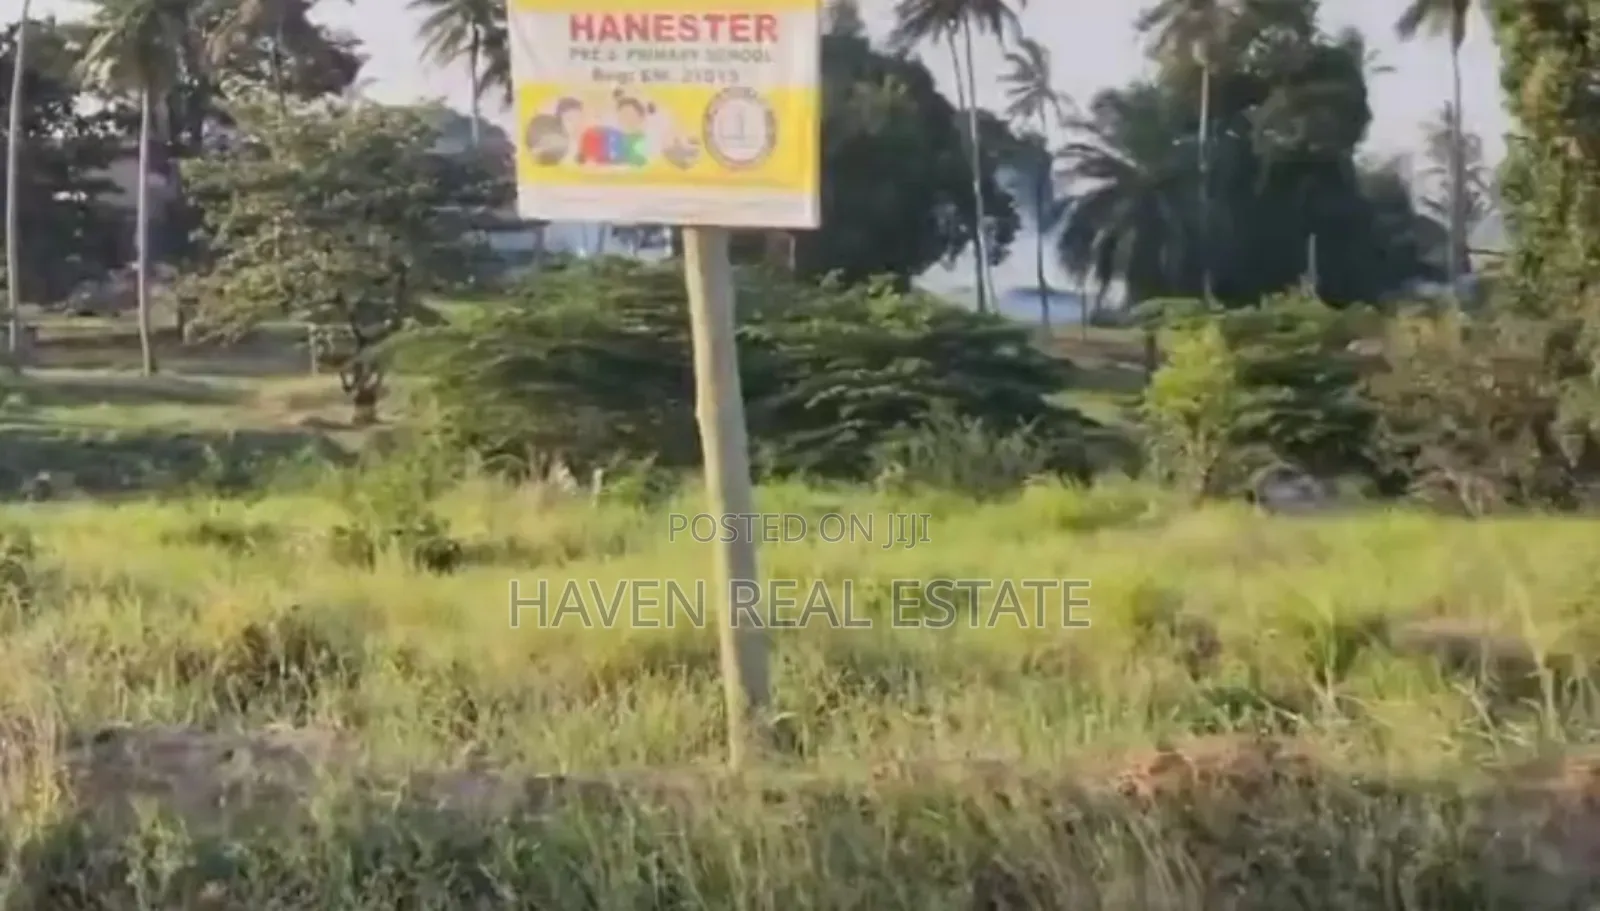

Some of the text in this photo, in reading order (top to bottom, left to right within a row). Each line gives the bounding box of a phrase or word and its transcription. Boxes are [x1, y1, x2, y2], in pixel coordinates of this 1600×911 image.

[569, 13, 779, 43] HANESTER
[626, 48, 699, 62] PRIMARY
[705, 48, 773, 63] SCHOOL
